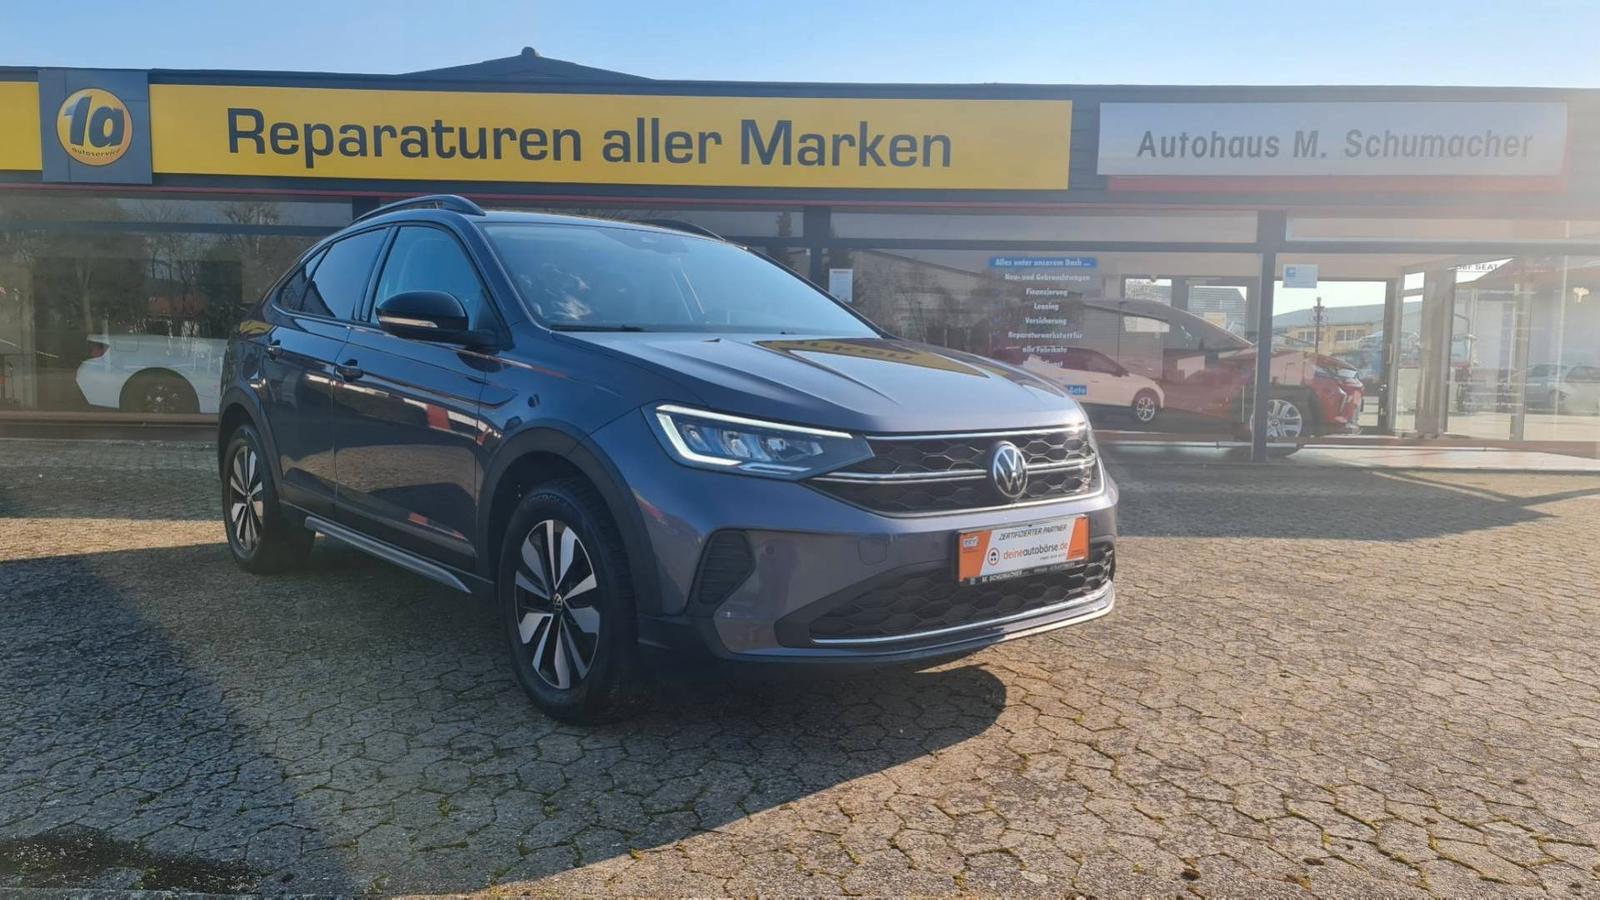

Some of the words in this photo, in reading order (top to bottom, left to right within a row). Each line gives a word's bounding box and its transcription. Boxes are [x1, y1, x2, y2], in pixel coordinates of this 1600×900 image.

[63, 95, 126, 149] 1a
[226, 106, 582, 169] Reparaturen
[601, 117, 723, 164] aller
[740, 119, 951, 168] Marken
[1136, 130, 1280, 159] Autohaus
[1292, 130, 1328, 158] M.
[1343, 129, 1534, 158] Schumacher
[995, 258, 1012, 266] Alles
[1065, 258, 1082, 266] Dach
[1025, 287, 1069, 297] Finanzierung
[1033, 302, 1060, 311] Leasing
[1024, 317, 1068, 326] Versicherung
[998, 527, 1043, 541] ZERTIFIZIERTER
[1043, 523, 1067, 534] PARTNER
